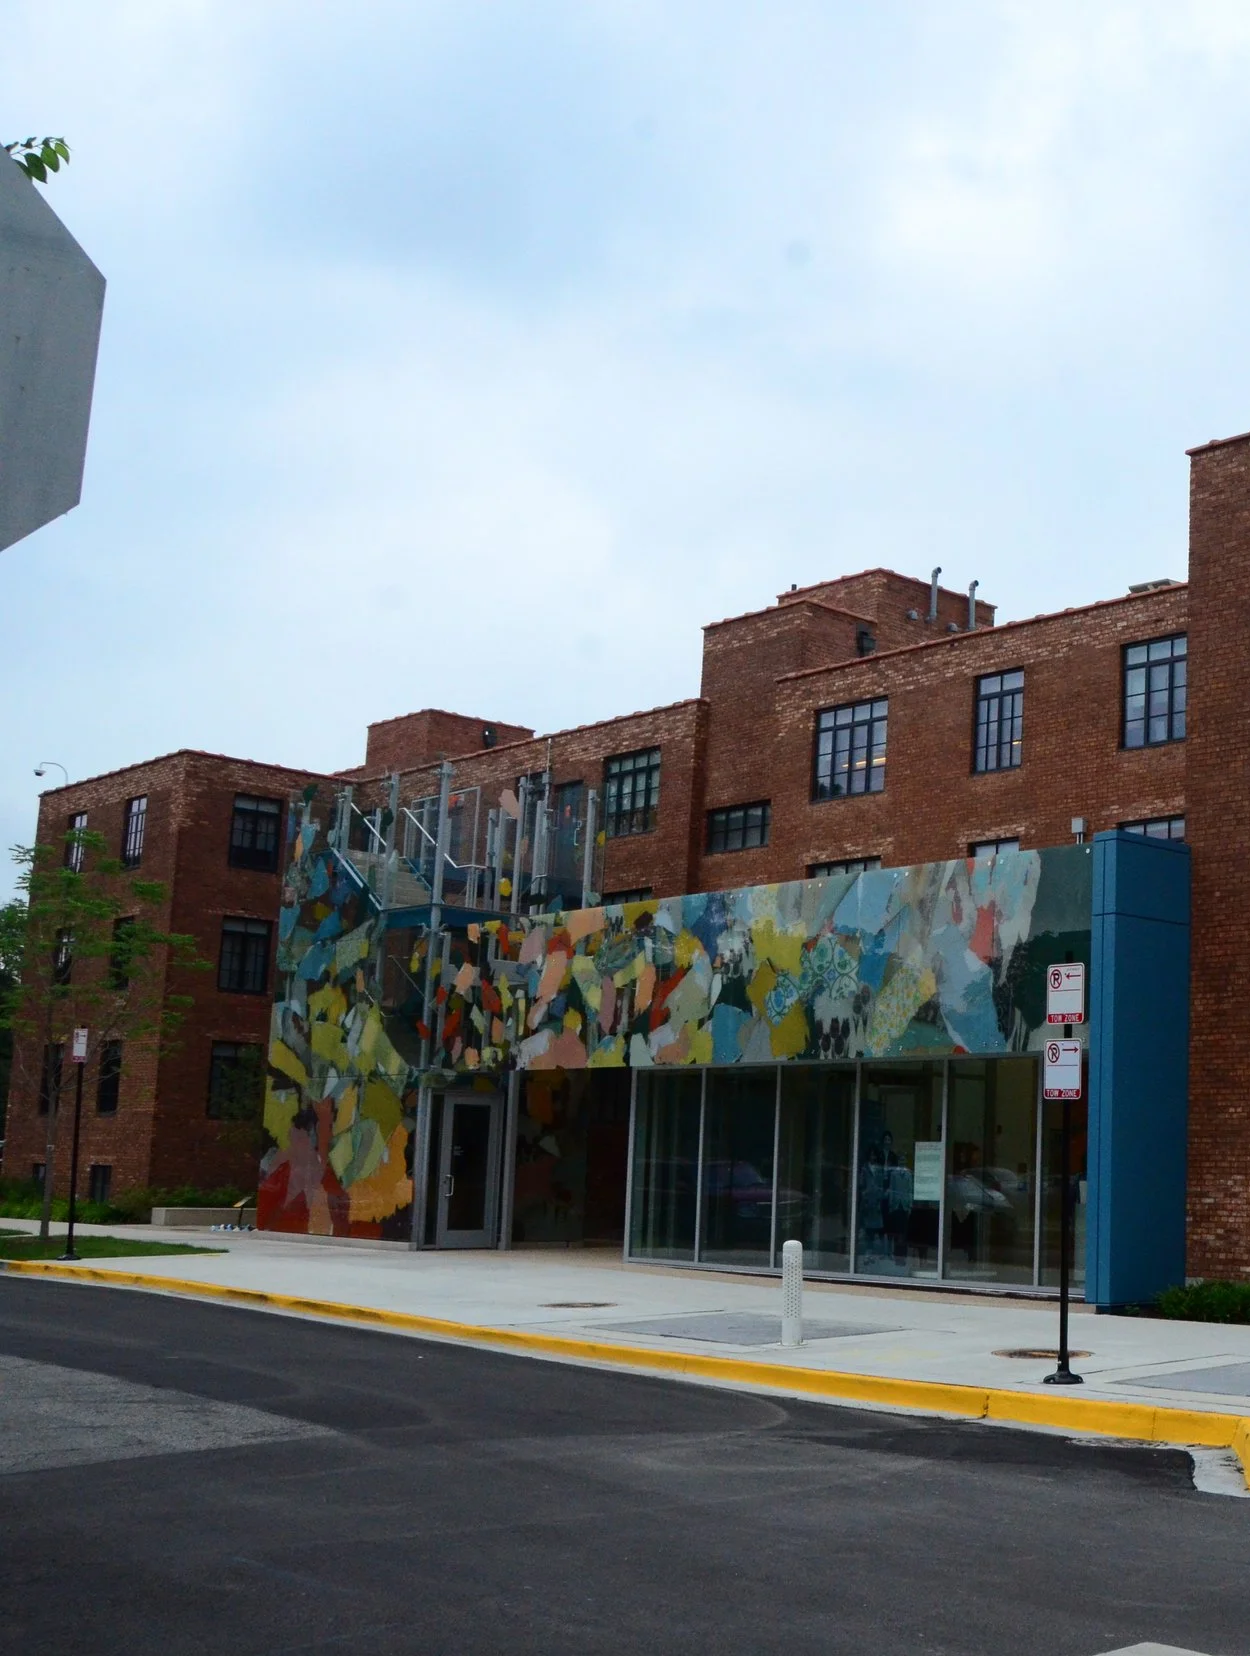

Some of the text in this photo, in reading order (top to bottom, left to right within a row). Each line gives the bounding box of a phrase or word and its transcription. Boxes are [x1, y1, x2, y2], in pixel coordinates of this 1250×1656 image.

[1050, 1013, 1080, 1023] TOW ZONE
[1046, 1089, 1077, 1098] TOW ZONE
